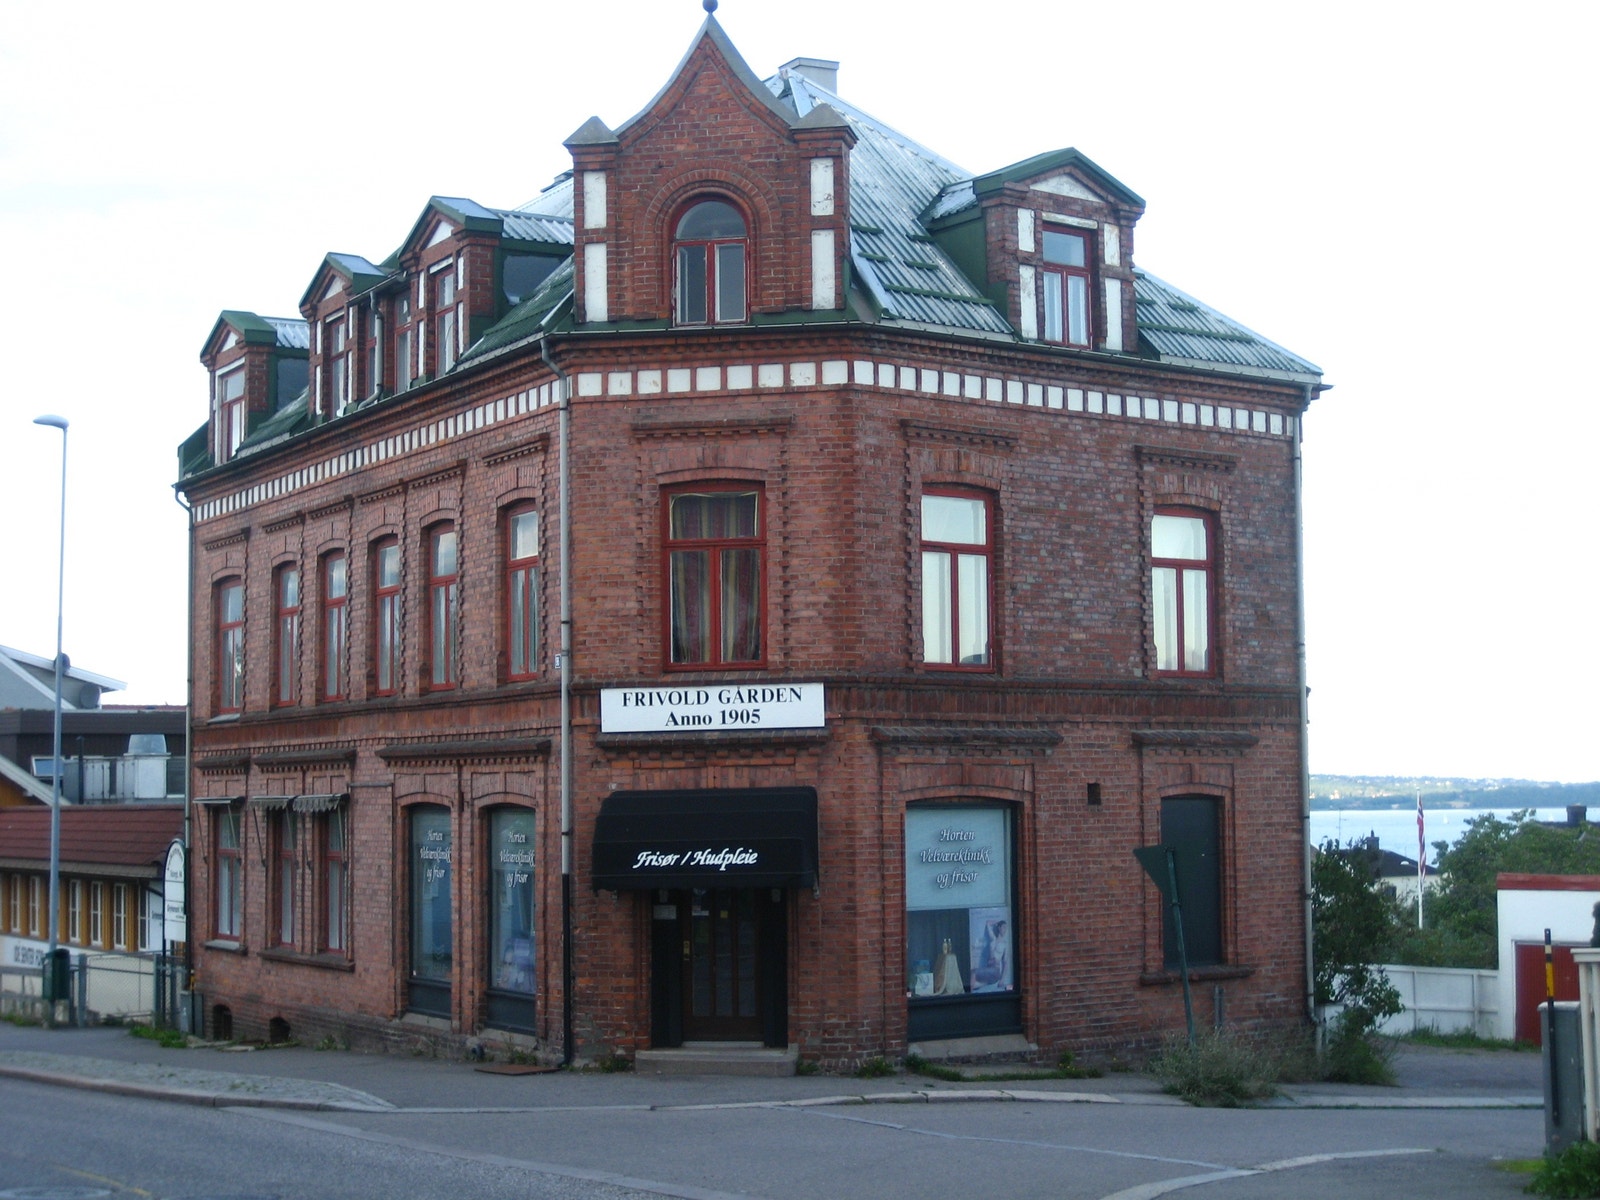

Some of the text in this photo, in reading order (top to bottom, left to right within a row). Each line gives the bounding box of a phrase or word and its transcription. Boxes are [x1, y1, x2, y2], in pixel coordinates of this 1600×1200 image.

[622, 686, 803, 707] FRIVOLD GÅRDEN
[665, 708, 761, 727] Anno 1905
[939, 828, 976, 842] Horten
[632, 851, 680, 869] Frisør
[690, 847, 758, 871] Hudpleie
[920, 847, 992, 866] Velværeklinikk
[936, 873, 950, 889] og
